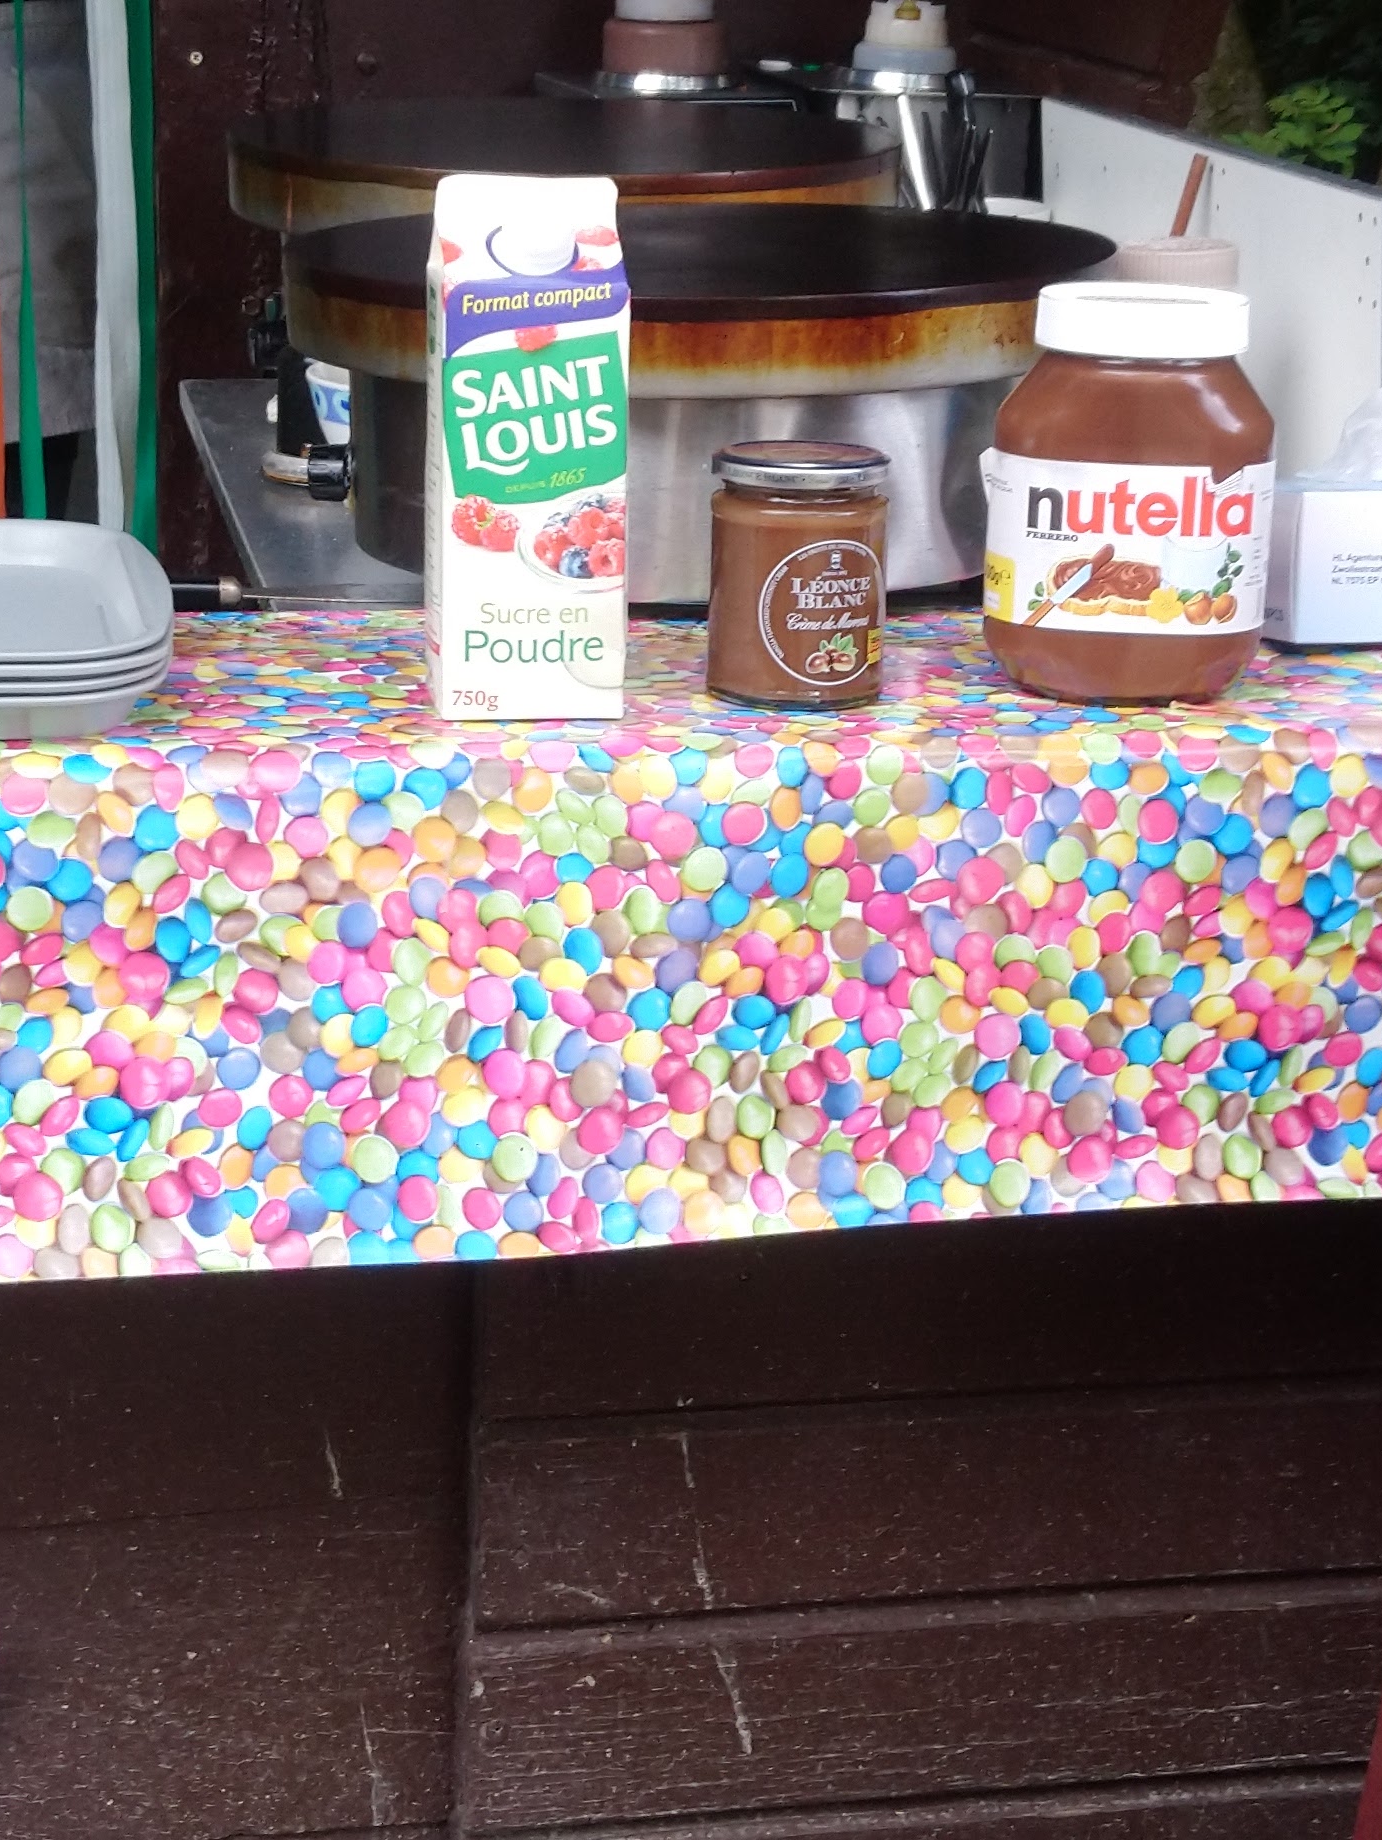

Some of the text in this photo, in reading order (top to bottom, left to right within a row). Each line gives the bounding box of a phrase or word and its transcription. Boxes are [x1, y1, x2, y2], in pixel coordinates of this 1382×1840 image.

[462, 282, 612, 315] Format compact
[451, 355, 610, 419] SAINT
[460, 404, 618, 477] LOUIS
[550, 467, 587, 488] 1865
[1027, 476, 1254, 538] nutella
[1026, 530, 1079, 542] FERRERO
[790, 576, 871, 594] LÉONCE
[795, 591, 867, 609] BLANC
[480, 602, 589, 625] Sucre en
[464, 629, 604, 664] Poudre
[452, 690, 499, 712] 750g
